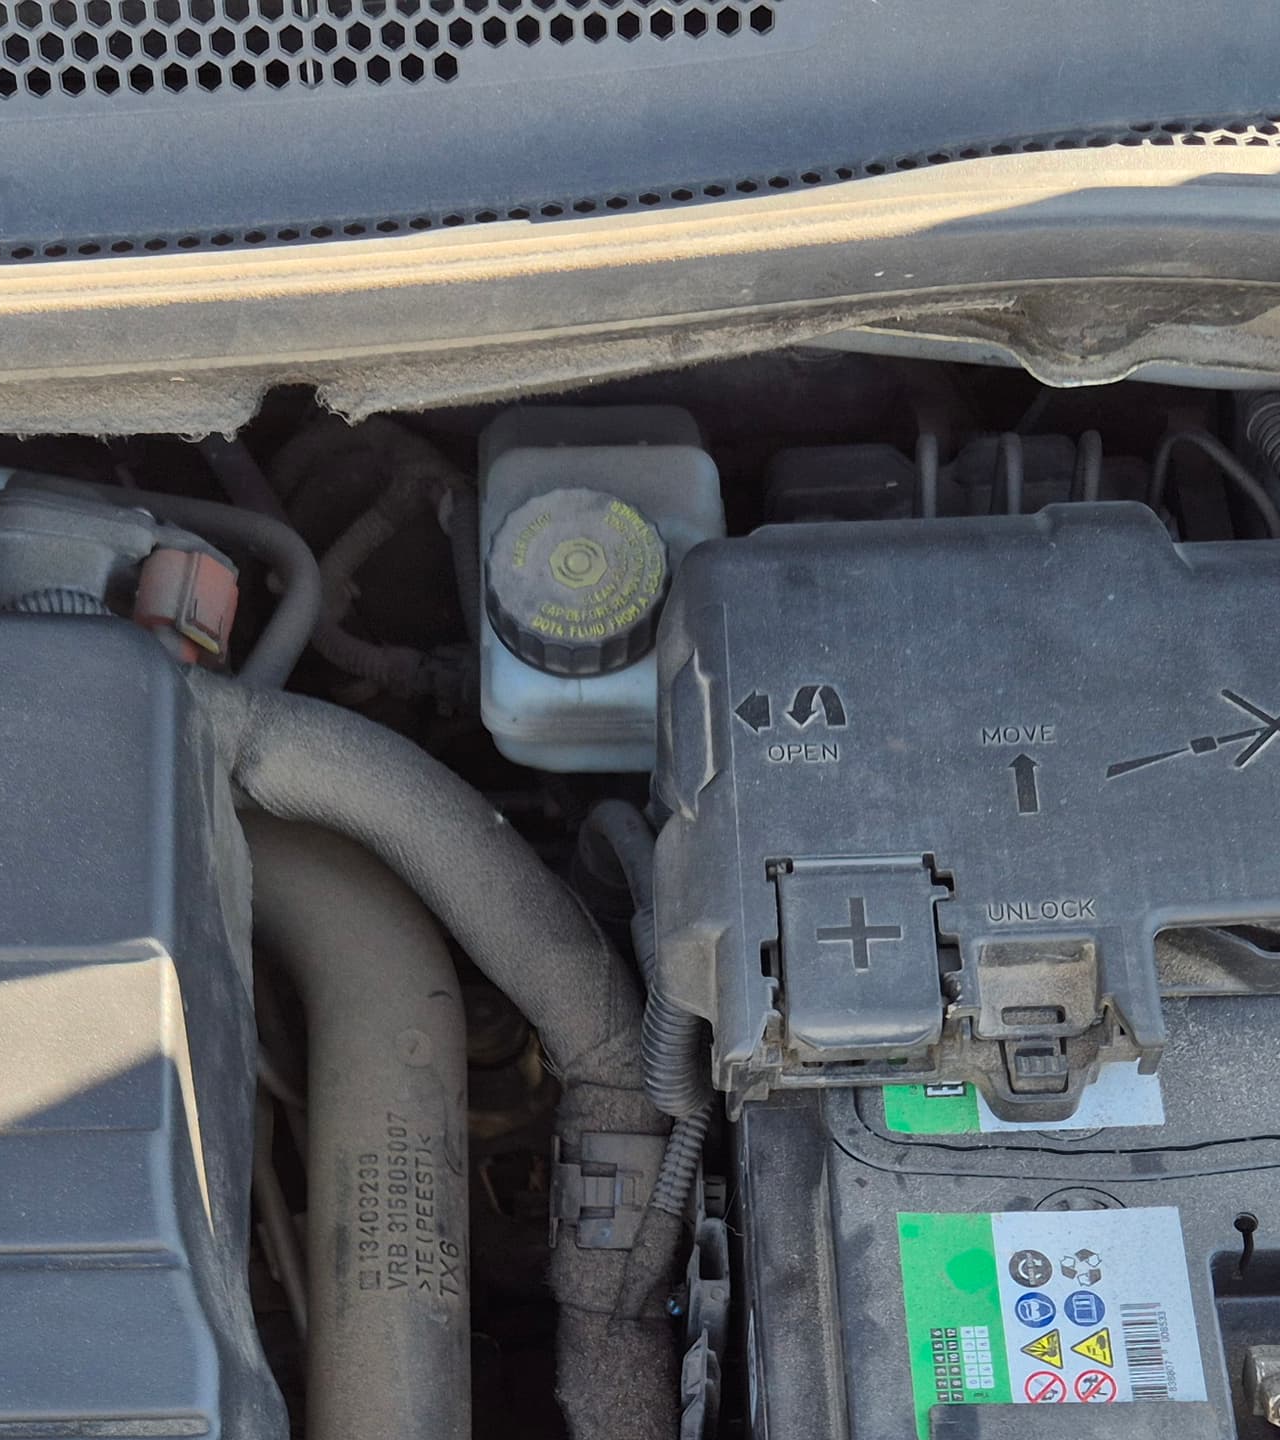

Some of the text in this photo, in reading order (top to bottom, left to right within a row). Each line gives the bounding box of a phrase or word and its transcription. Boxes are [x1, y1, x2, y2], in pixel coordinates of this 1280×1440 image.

[531, 615, 564, 637] DOT4
[570, 622, 606, 638] FLUID
[609, 603, 641, 631] FROM
[980, 723, 1055, 746] MOVE
[767, 743, 839, 762] OPEN
[987, 898, 1096, 923] UNLOCK
[388, 1243, 409, 1291] VRB
[439, 1239, 460, 1297] TX6
